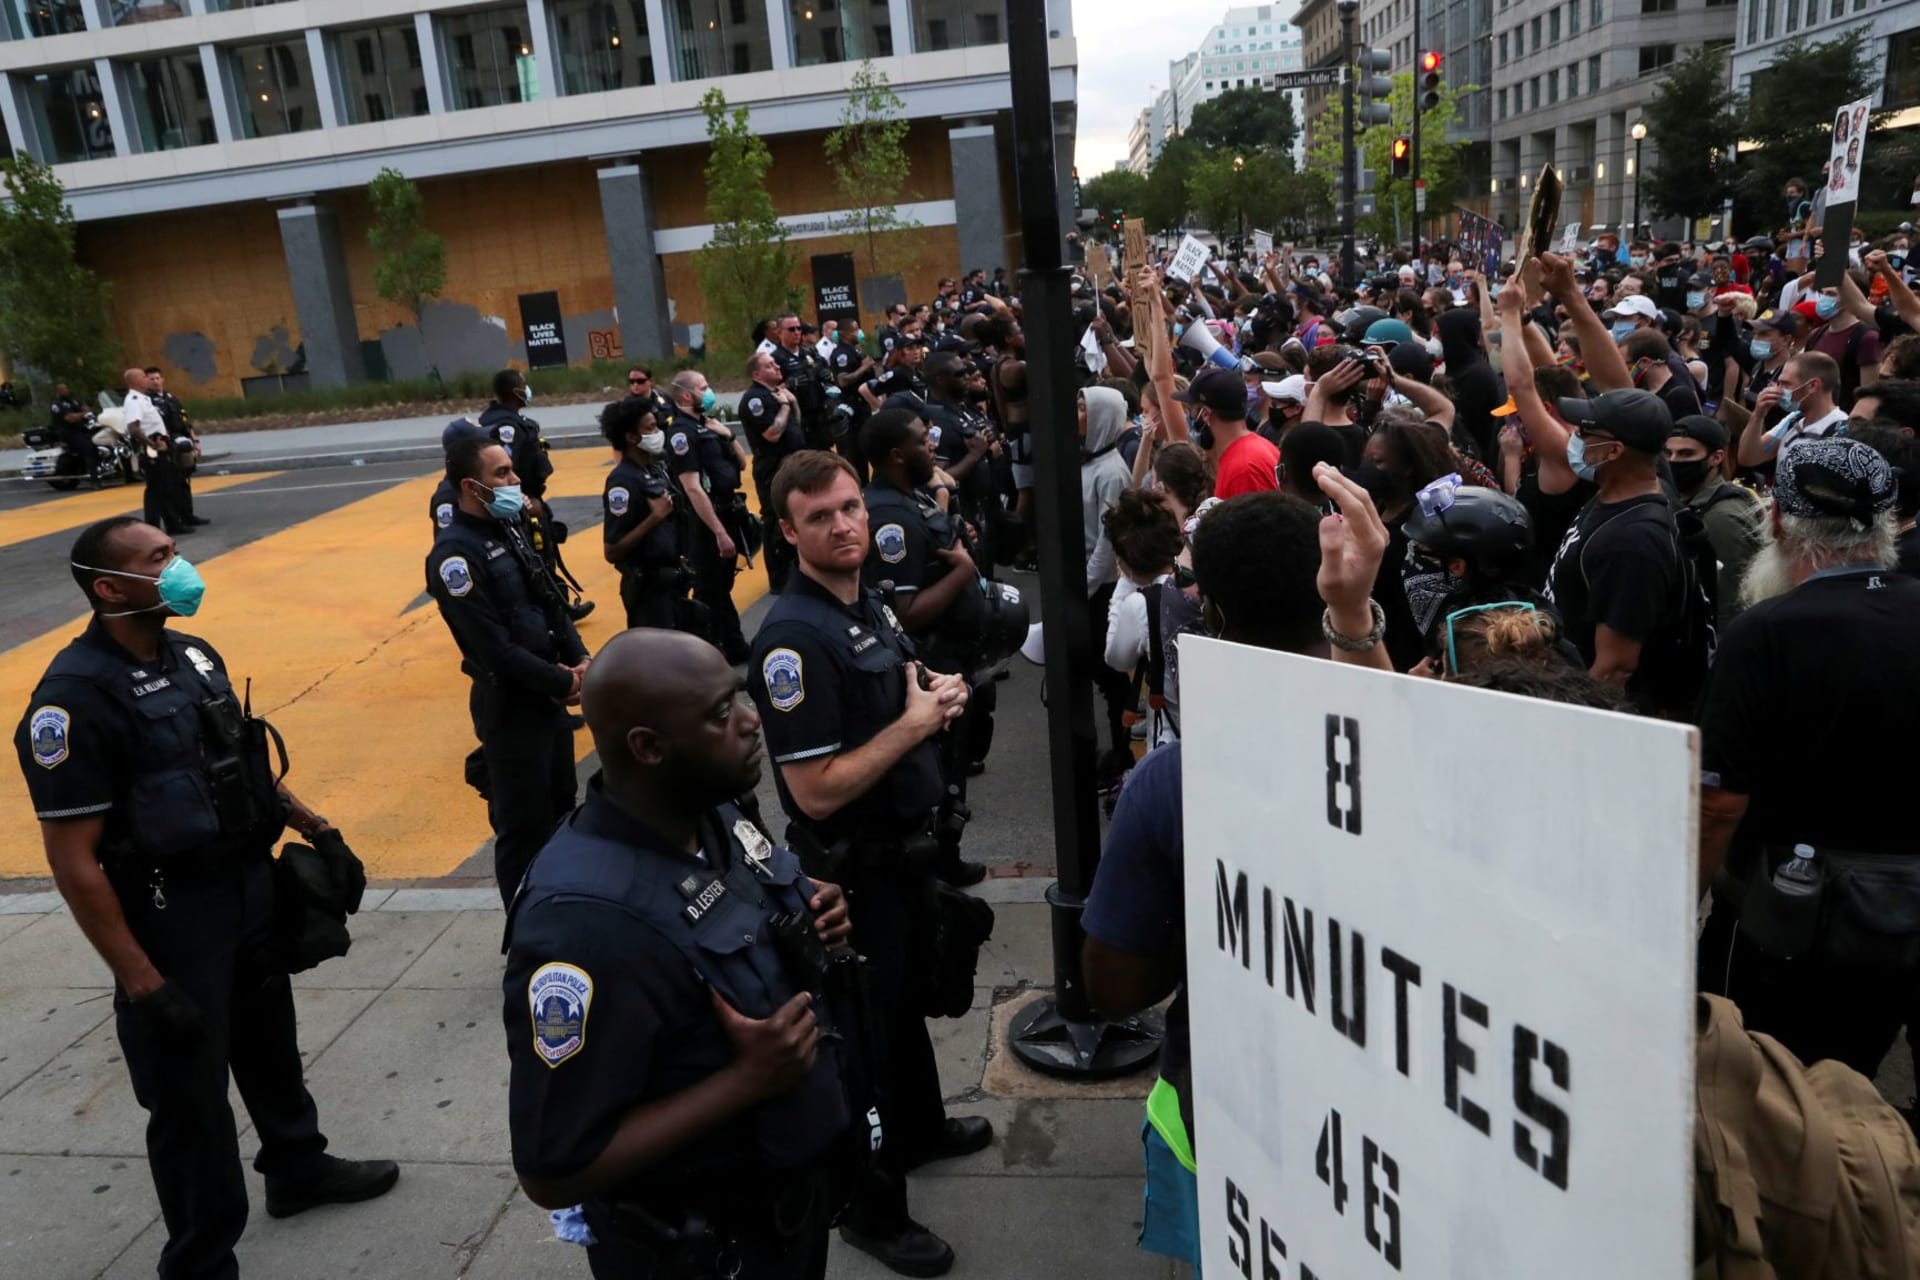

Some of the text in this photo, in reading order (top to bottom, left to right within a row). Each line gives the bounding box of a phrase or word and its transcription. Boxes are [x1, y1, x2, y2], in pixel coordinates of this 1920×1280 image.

[1311, 72, 1330, 85] Matter
[821, 285, 849, 295] BLACK
[825, 293, 848, 302] LIVES
[819, 300, 855, 310] MATTER.
[529, 323, 556, 332] BLACK
[532, 331, 555, 339] LIVES
[528, 337, 562, 347] MATTER.
[1325, 713, 1362, 836] 8
[687, 905, 703, 919] D.
[696, 879, 726, 910] LESTER
[531, 972, 588, 995] METROPOLITAN POLICE
[1215, 858, 1571, 1192] MINUTES
[1315, 1107, 1402, 1272] 46
